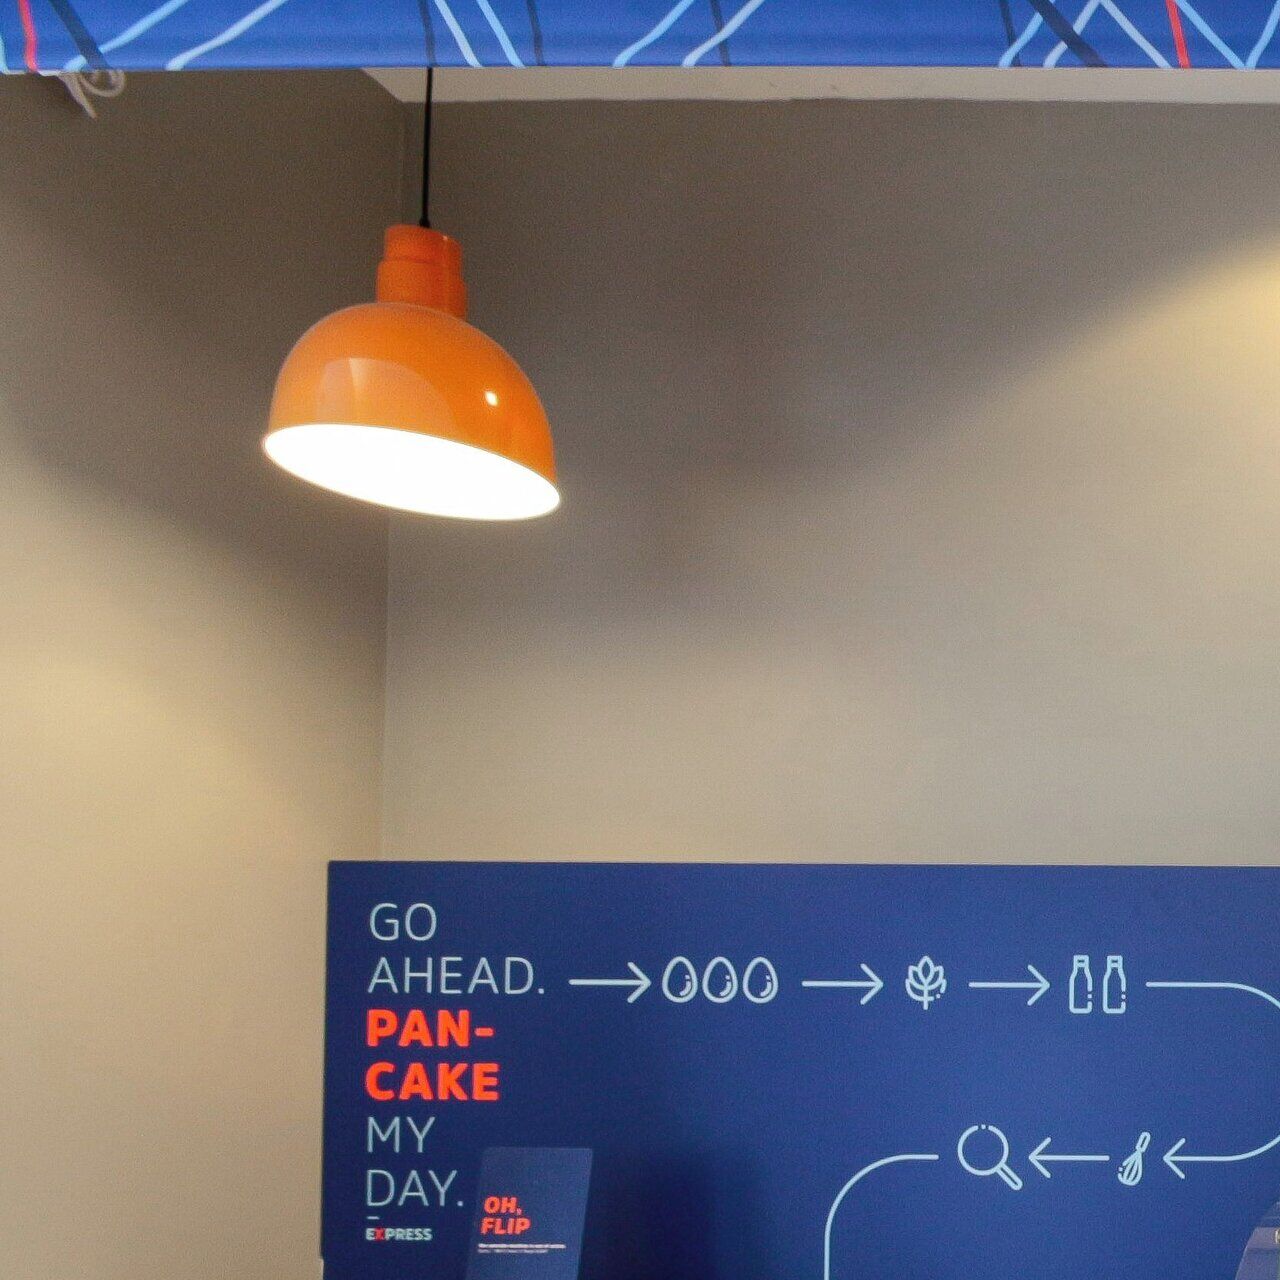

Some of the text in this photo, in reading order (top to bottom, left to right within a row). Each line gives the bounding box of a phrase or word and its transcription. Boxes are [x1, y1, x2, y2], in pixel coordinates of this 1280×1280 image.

[369, 902, 438, 942] GO
[367, 956, 545, 995] AHEAD.
[366, 1008, 495, 1048] PAN-
[364, 1061, 500, 1102] CAKE
[366, 1115, 436, 1154] MY
[366, 1168, 464, 1207] DAY.
[484, 1196, 522, 1216] OH,
[365, 1227, 433, 1242] EXPRESS
[480, 1217, 531, 1235] FLIP
